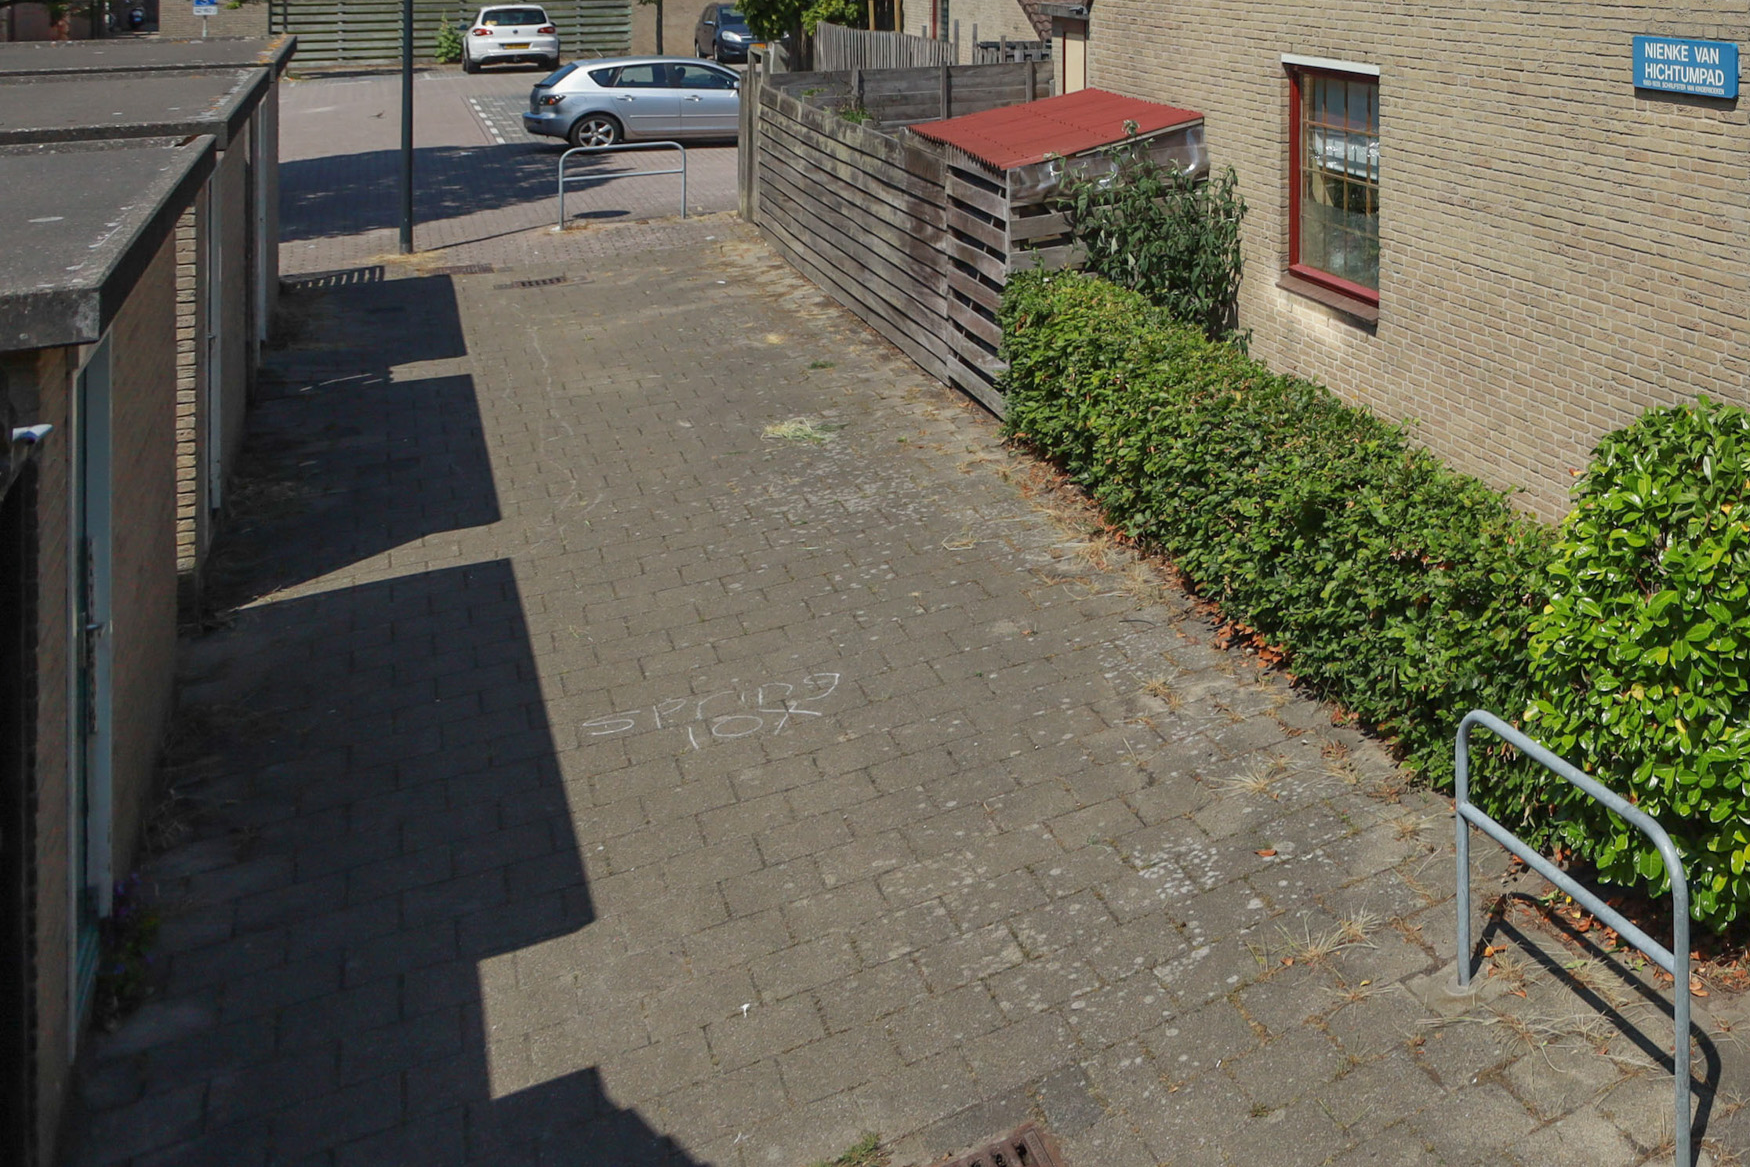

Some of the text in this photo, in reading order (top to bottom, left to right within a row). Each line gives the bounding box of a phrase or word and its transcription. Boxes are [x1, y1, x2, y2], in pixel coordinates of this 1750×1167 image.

[1644, 42, 1719, 64] NIENKE VAN
[1645, 63, 1724, 86] HICHTUMPAD
